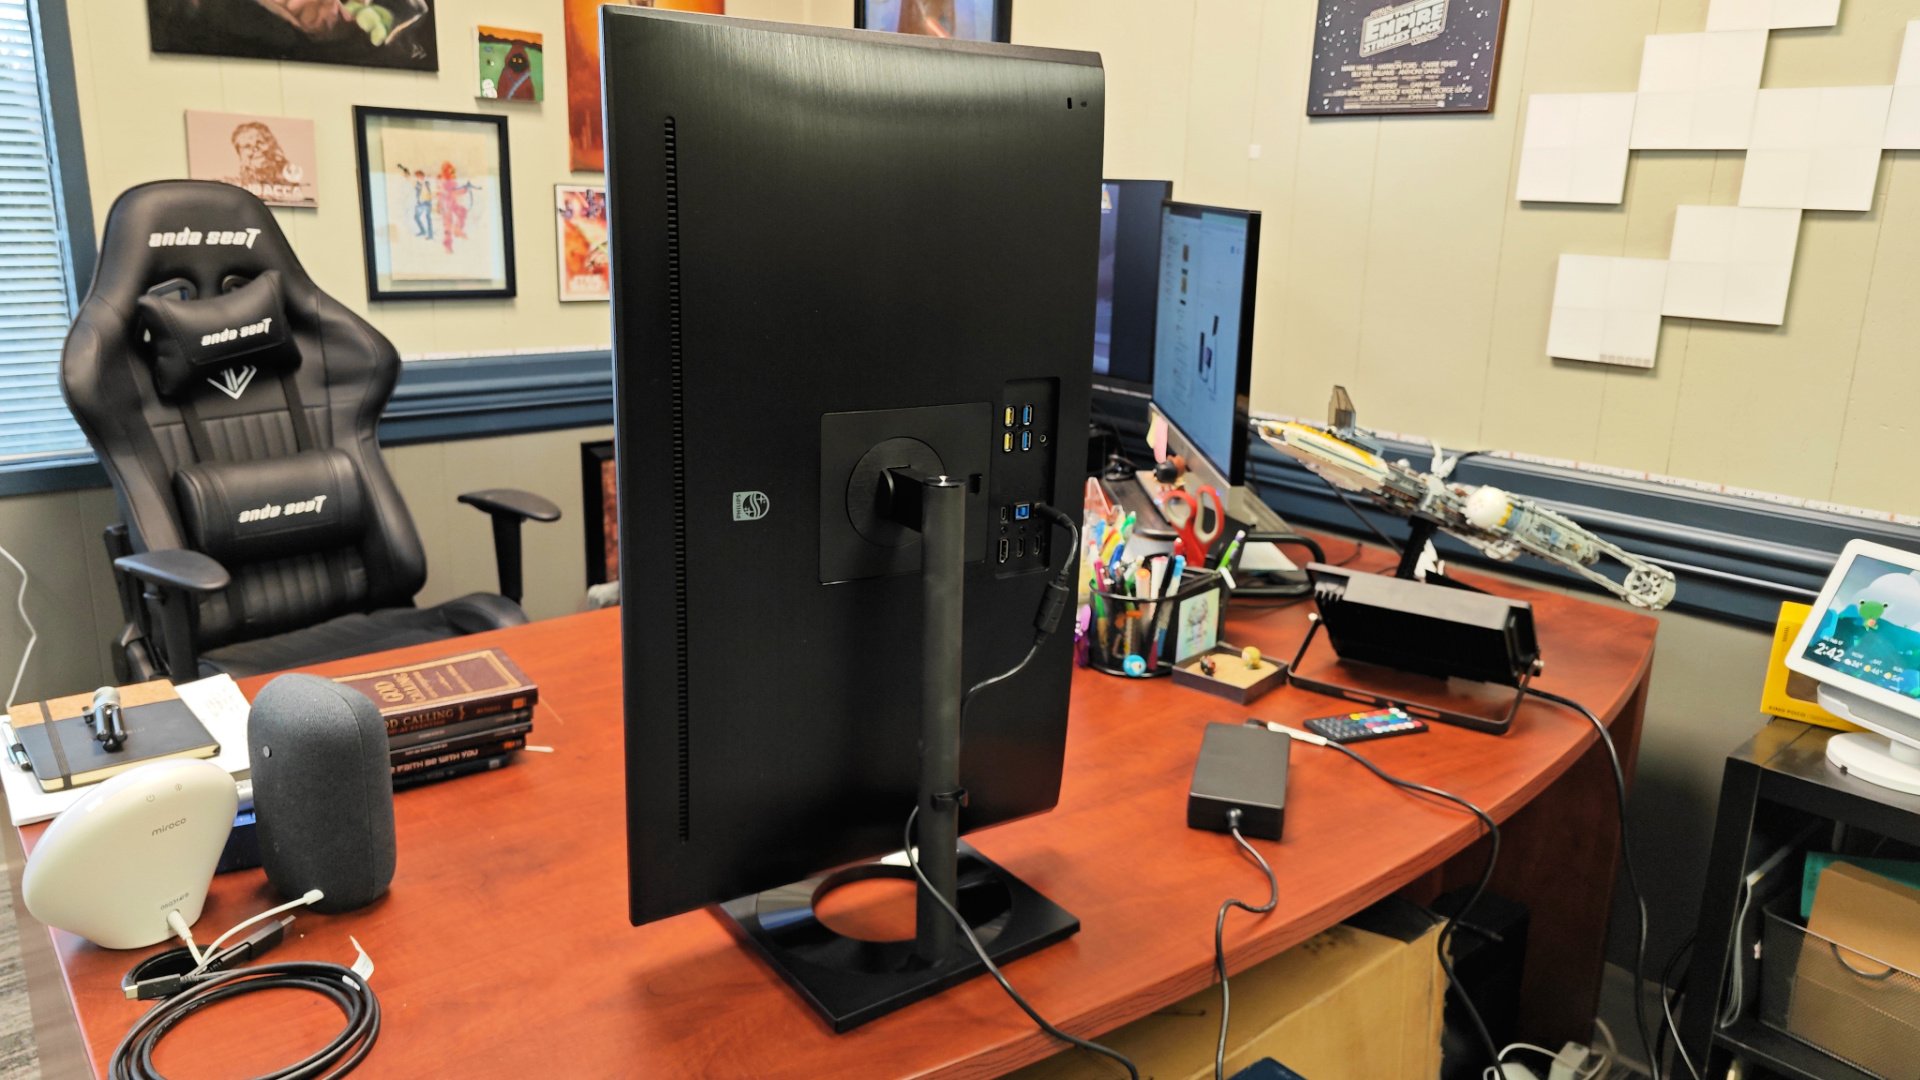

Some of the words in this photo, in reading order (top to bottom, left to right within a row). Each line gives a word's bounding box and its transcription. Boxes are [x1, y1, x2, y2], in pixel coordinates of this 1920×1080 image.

[1365, 3, 1445, 42] EMPIRE
[1363, 30, 1411, 53] STRIKES
[1411, 20, 1442, 38] BACK
[1813, 642, 1845, 662] 2:42
[384, 719, 398, 729] OD
[403, 708, 454, 725] CALLING
[461, 748, 479, 760] YOU
[152, 818, 187, 836] miroco
